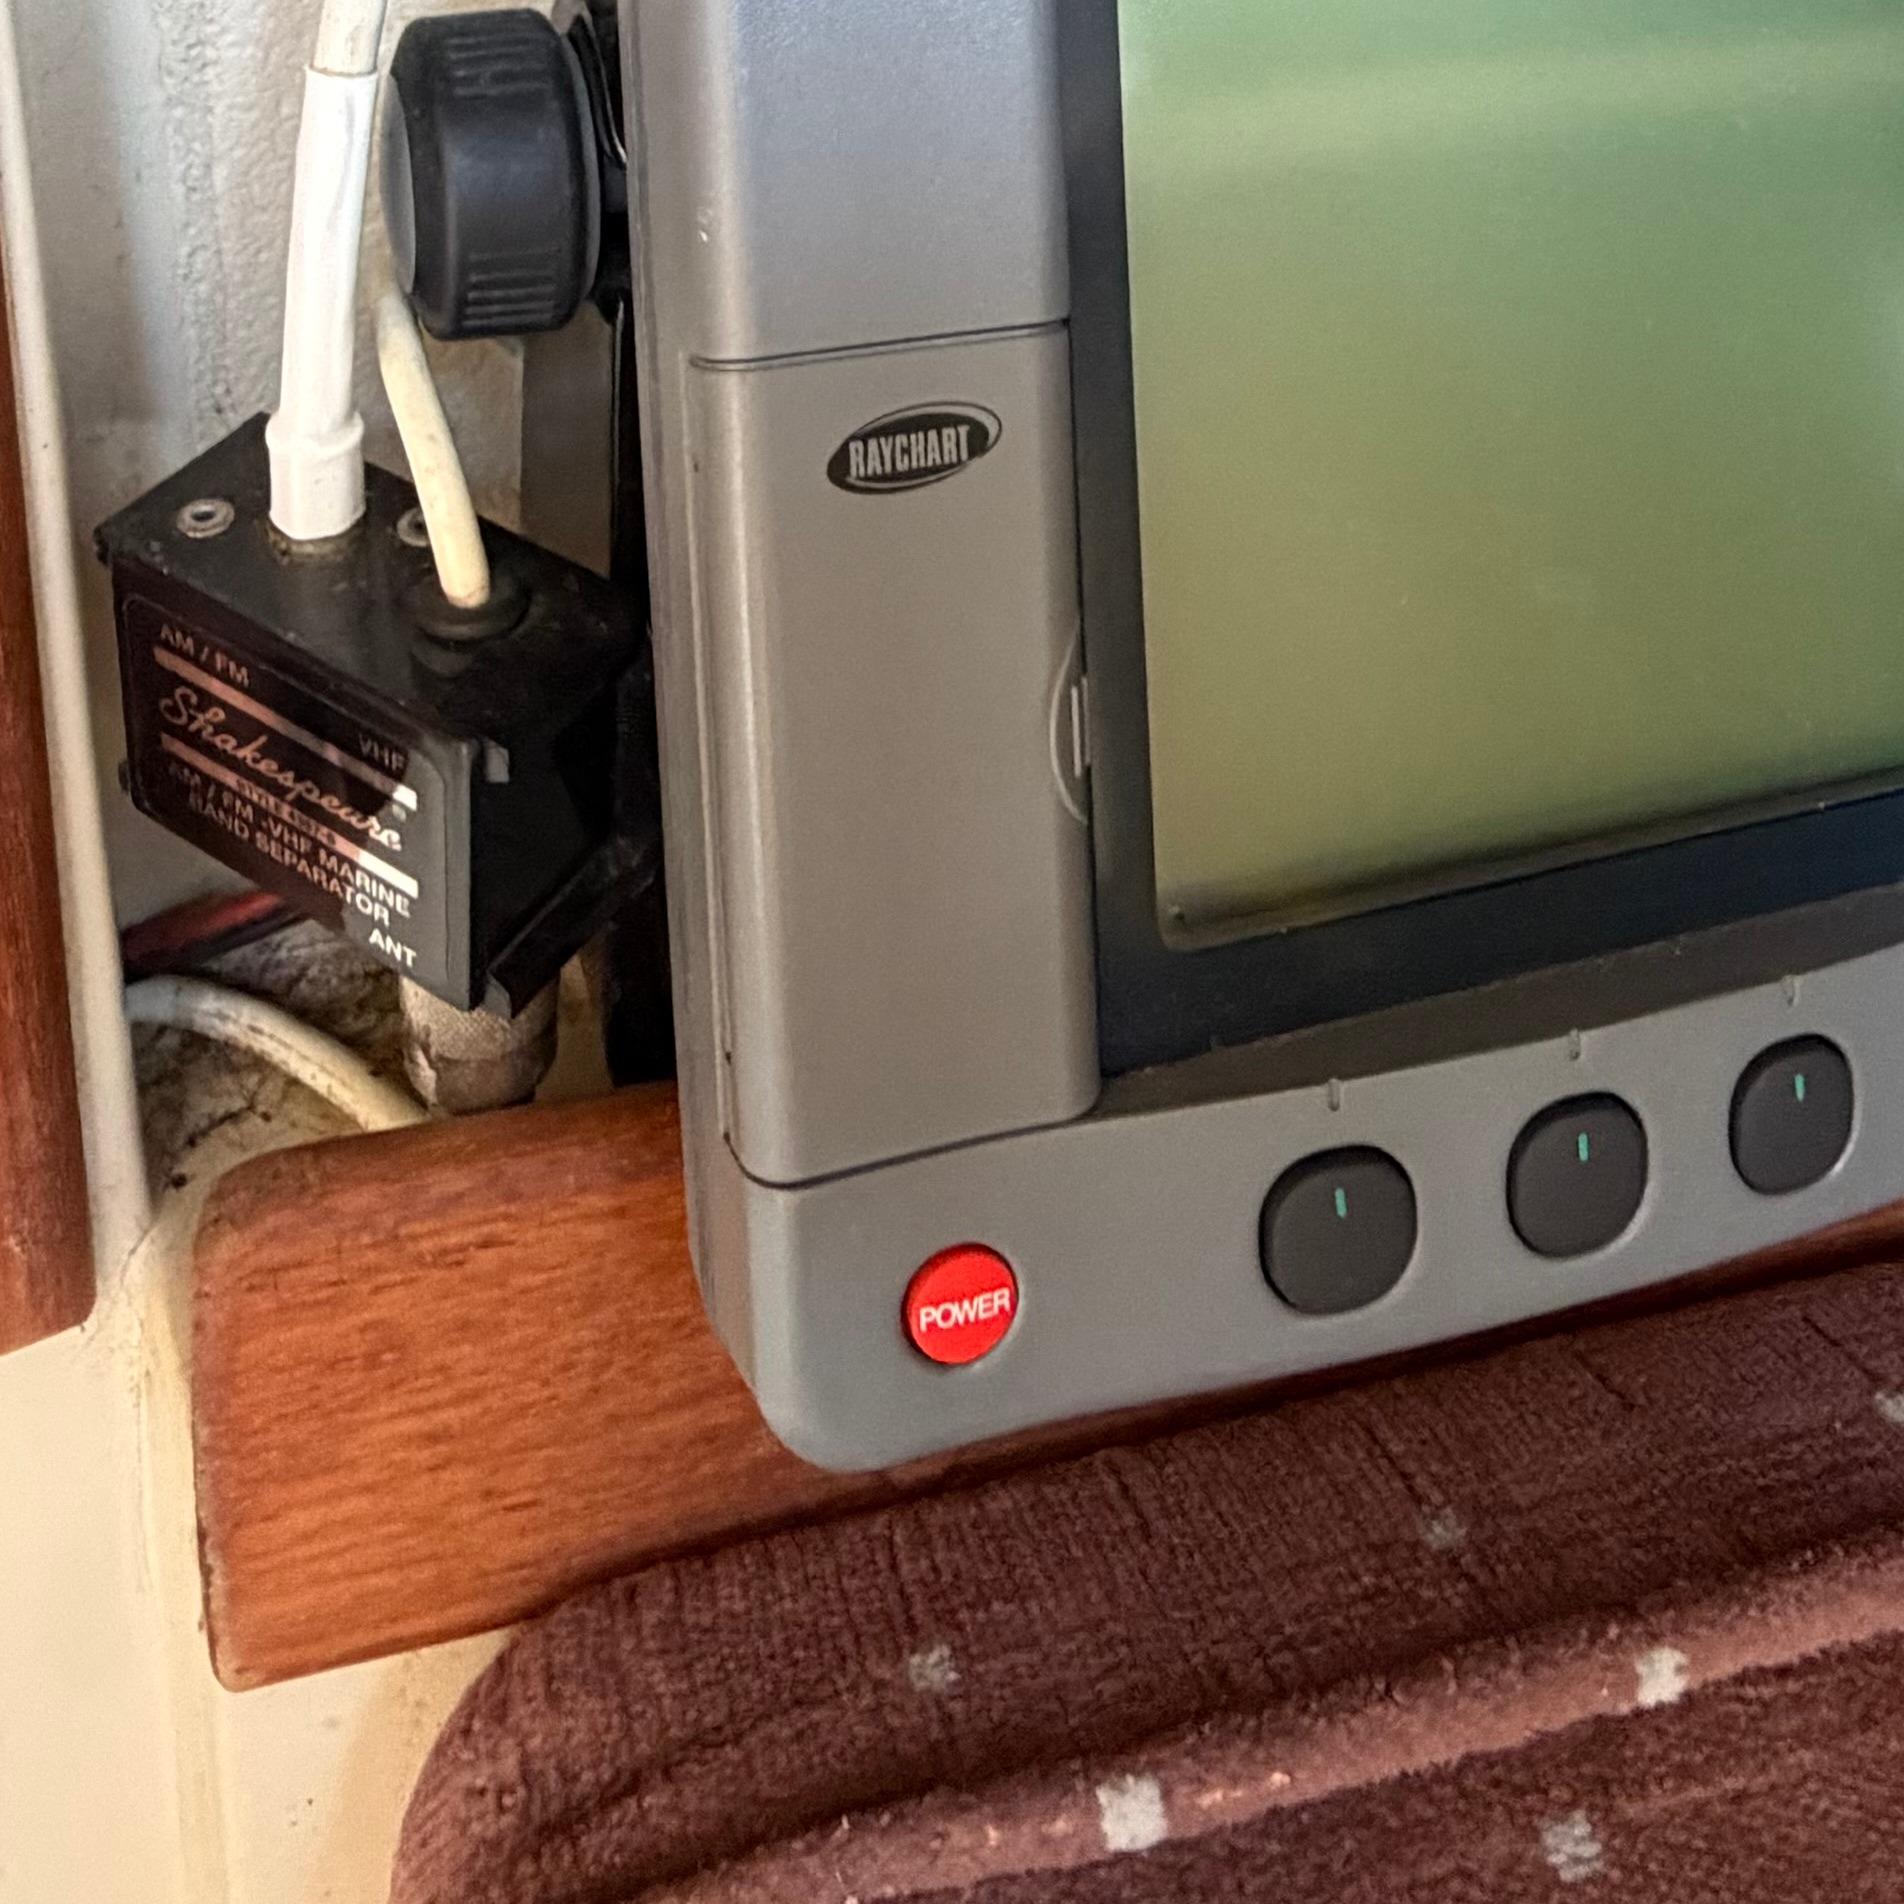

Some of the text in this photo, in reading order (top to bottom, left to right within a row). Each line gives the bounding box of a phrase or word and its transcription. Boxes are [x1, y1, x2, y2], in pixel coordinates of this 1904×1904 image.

[848, 424, 970, 480] RAYCHART
[159, 686, 402, 852] Shakespeare
[358, 732, 406, 774] VHF
[255, 821, 391, 927] SEPARATOR
[319, 848, 411, 919] MARINE
[369, 928, 417, 968] ANT
[919, 1287, 1011, 1333] POWER
